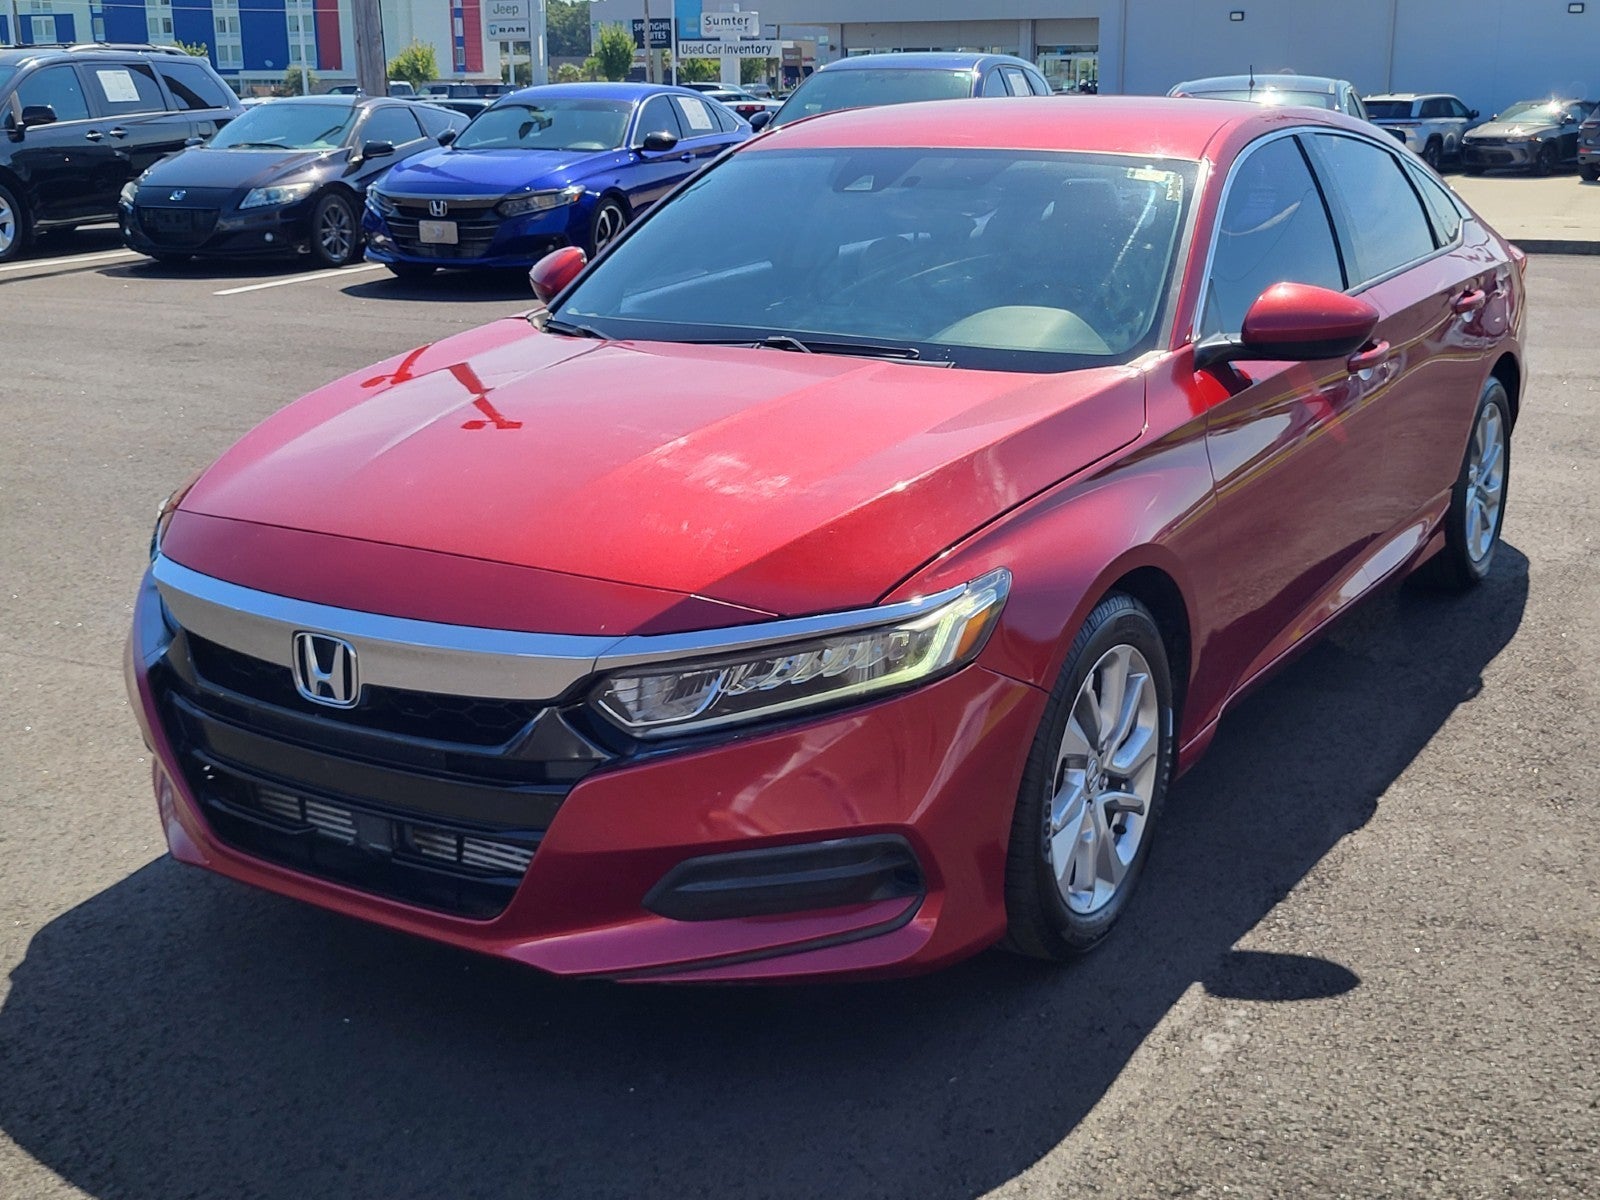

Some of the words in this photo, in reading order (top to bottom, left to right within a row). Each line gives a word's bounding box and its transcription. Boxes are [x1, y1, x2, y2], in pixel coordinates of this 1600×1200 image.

[493, 3, 519, 16] Jeep
[705, 15, 749, 26] Sumter
[681, 43, 704, 54] Used
[706, 43, 722, 54] Car
[724, 43, 772, 56] Inventory
